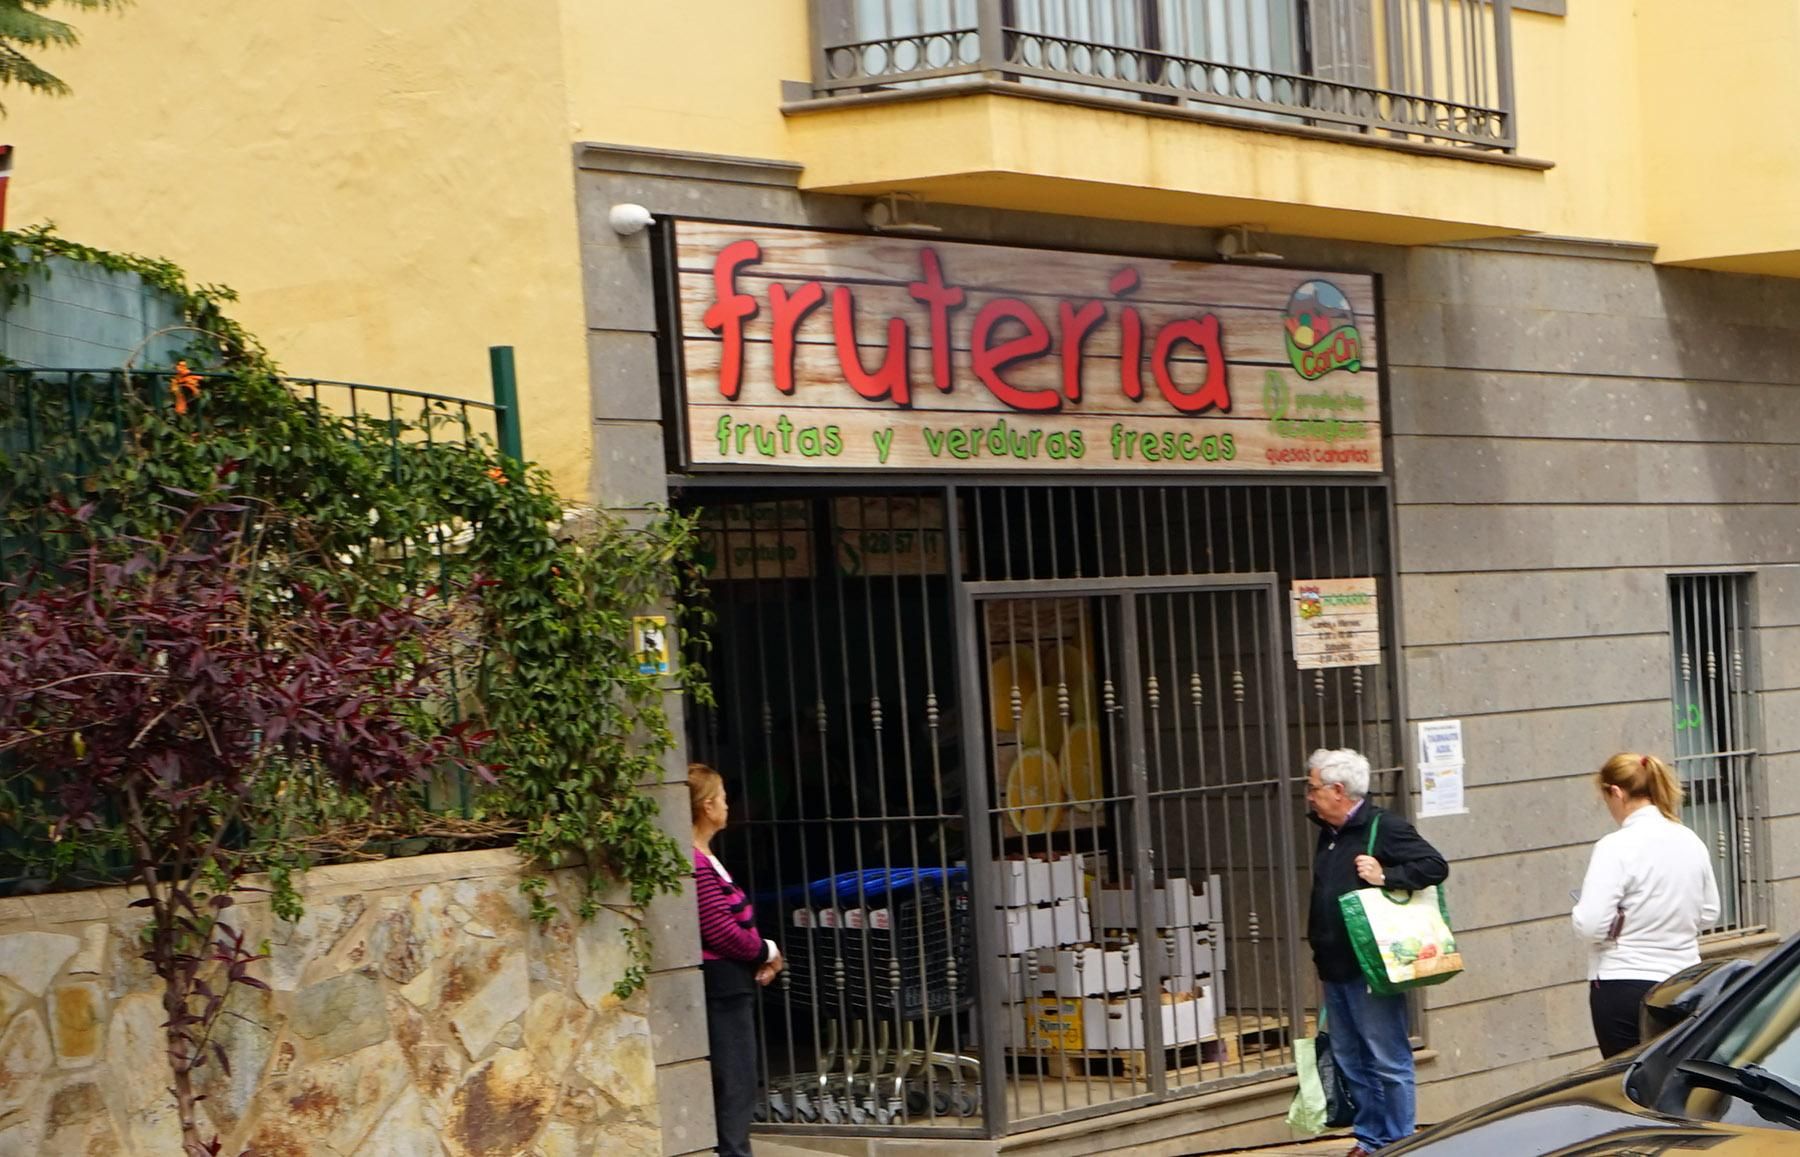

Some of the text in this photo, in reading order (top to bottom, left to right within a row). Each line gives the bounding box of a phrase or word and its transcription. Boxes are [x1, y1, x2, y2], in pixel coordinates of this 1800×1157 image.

[716, 415, 1236, 463] frutas y verduras frescas
